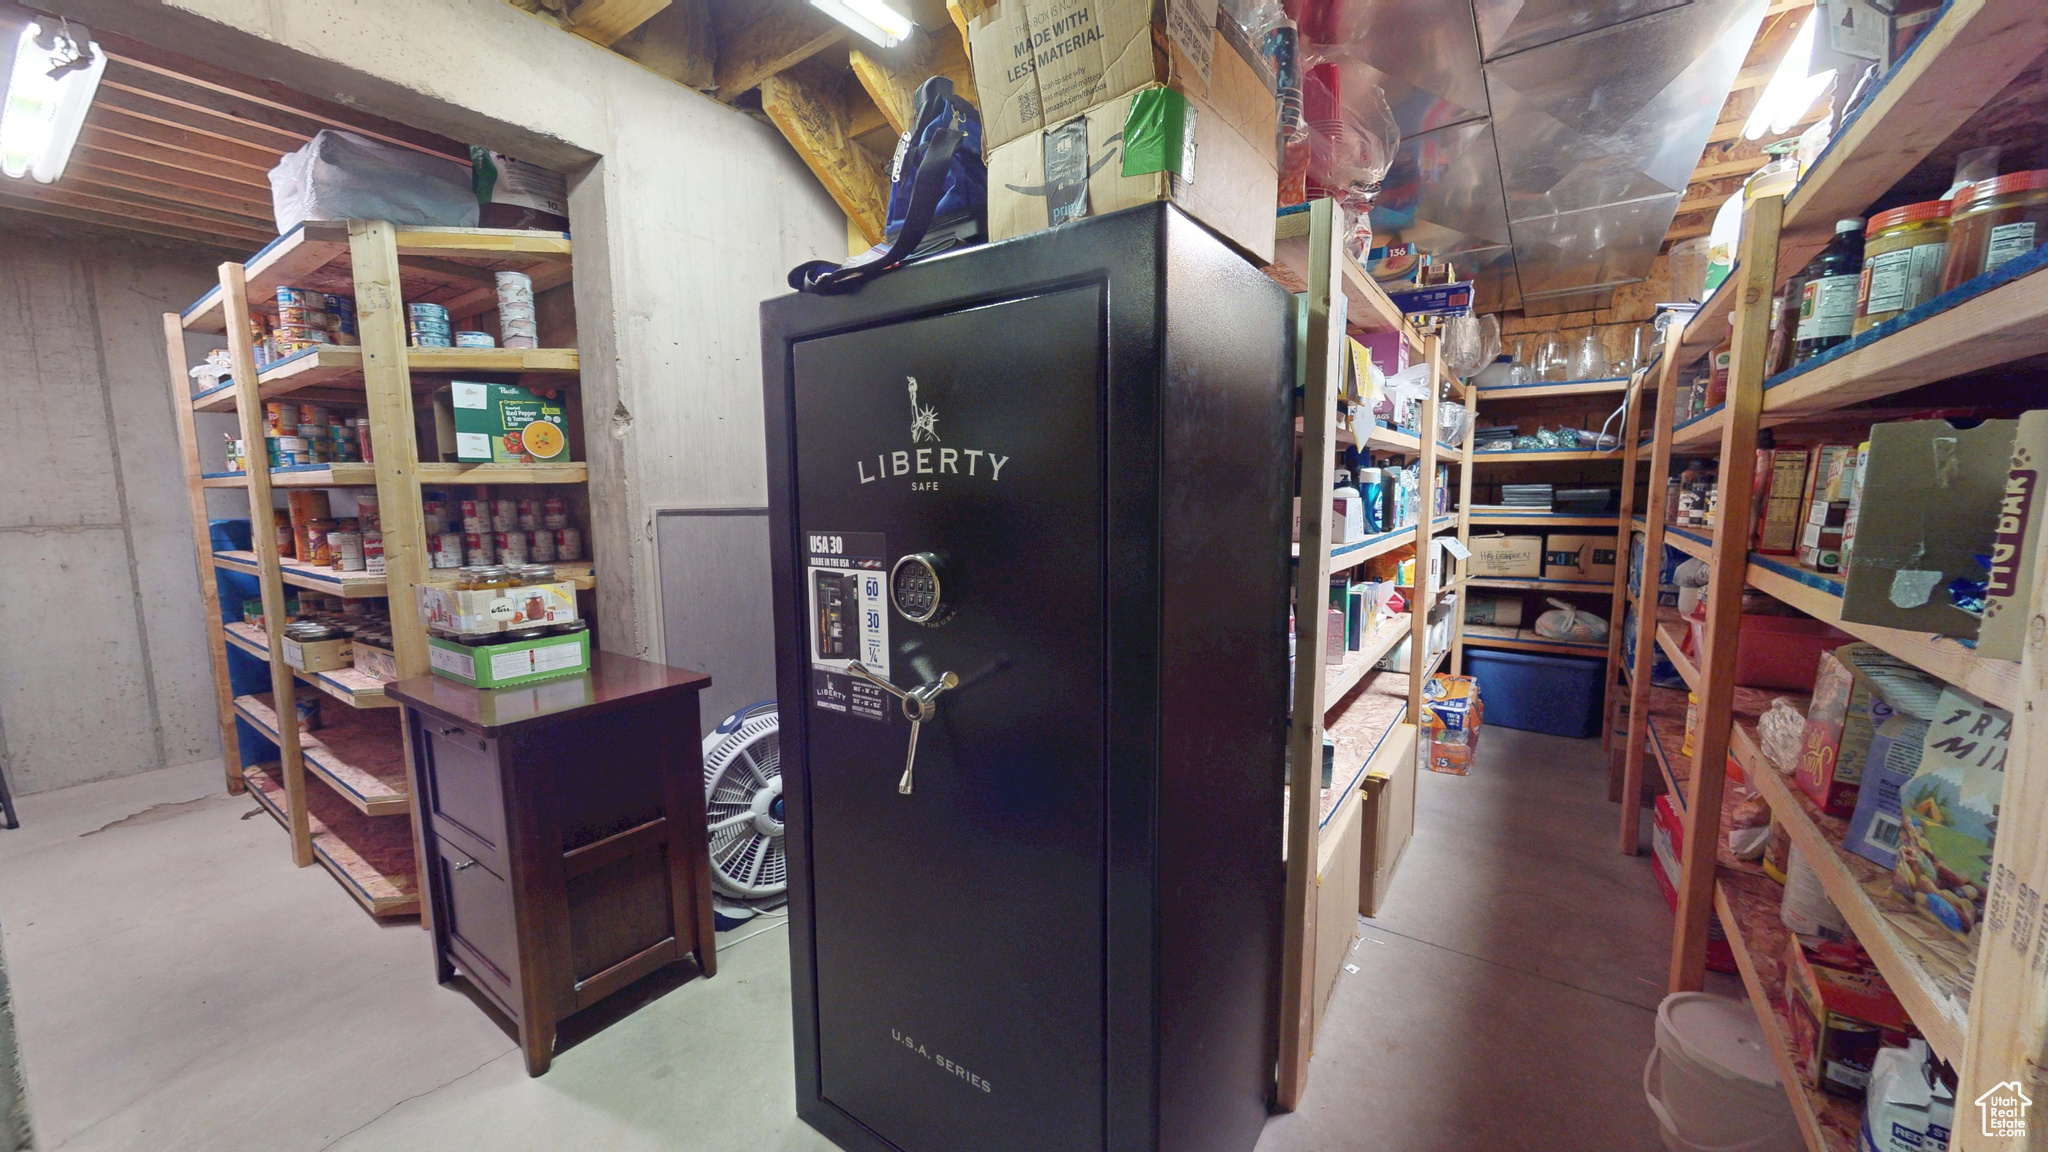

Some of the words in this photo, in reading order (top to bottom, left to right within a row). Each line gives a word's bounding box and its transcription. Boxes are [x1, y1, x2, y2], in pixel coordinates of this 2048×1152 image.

[1033, 10, 1050, 28] BOX
[1050, 4, 1058, 17] IS
[1060, 0, 1077, 12] NO
[1013, 27, 1051, 59] MADE
[1052, 7, 1089, 37] WITH
[1007, 57, 1037, 84] LESS
[1037, 24, 1105, 68] MATERIAL
[1041, 80, 1056, 92] Scan
[1062, 72, 1073, 82] see
[1073, 66, 1087, 77] why
[1042, 93, 1055, 103] less
[1054, 80, 1078, 98] material
[547, 201, 558, 211] 10
[1389, 247, 1407, 257] 136
[498, 386, 520, 395] Pacific
[857, 448, 1009, 484] LIBERTY
[911, 482, 939, 491] SAFE
[810, 535, 829, 553] USA
[830, 535, 843, 554] 30
[811, 557, 824, 566] MADE
[830, 558, 839, 567] THE
[840, 559, 850, 567] USA
[866, 580, 879, 597] 60
[866, 612, 880, 629] 30
[816, 688, 847, 701] LIBERTY
[1435, 757, 1449, 768] 15
[892, 1028, 931, 1059] U.S.A.
[936, 1054, 991, 1093] SERIES
